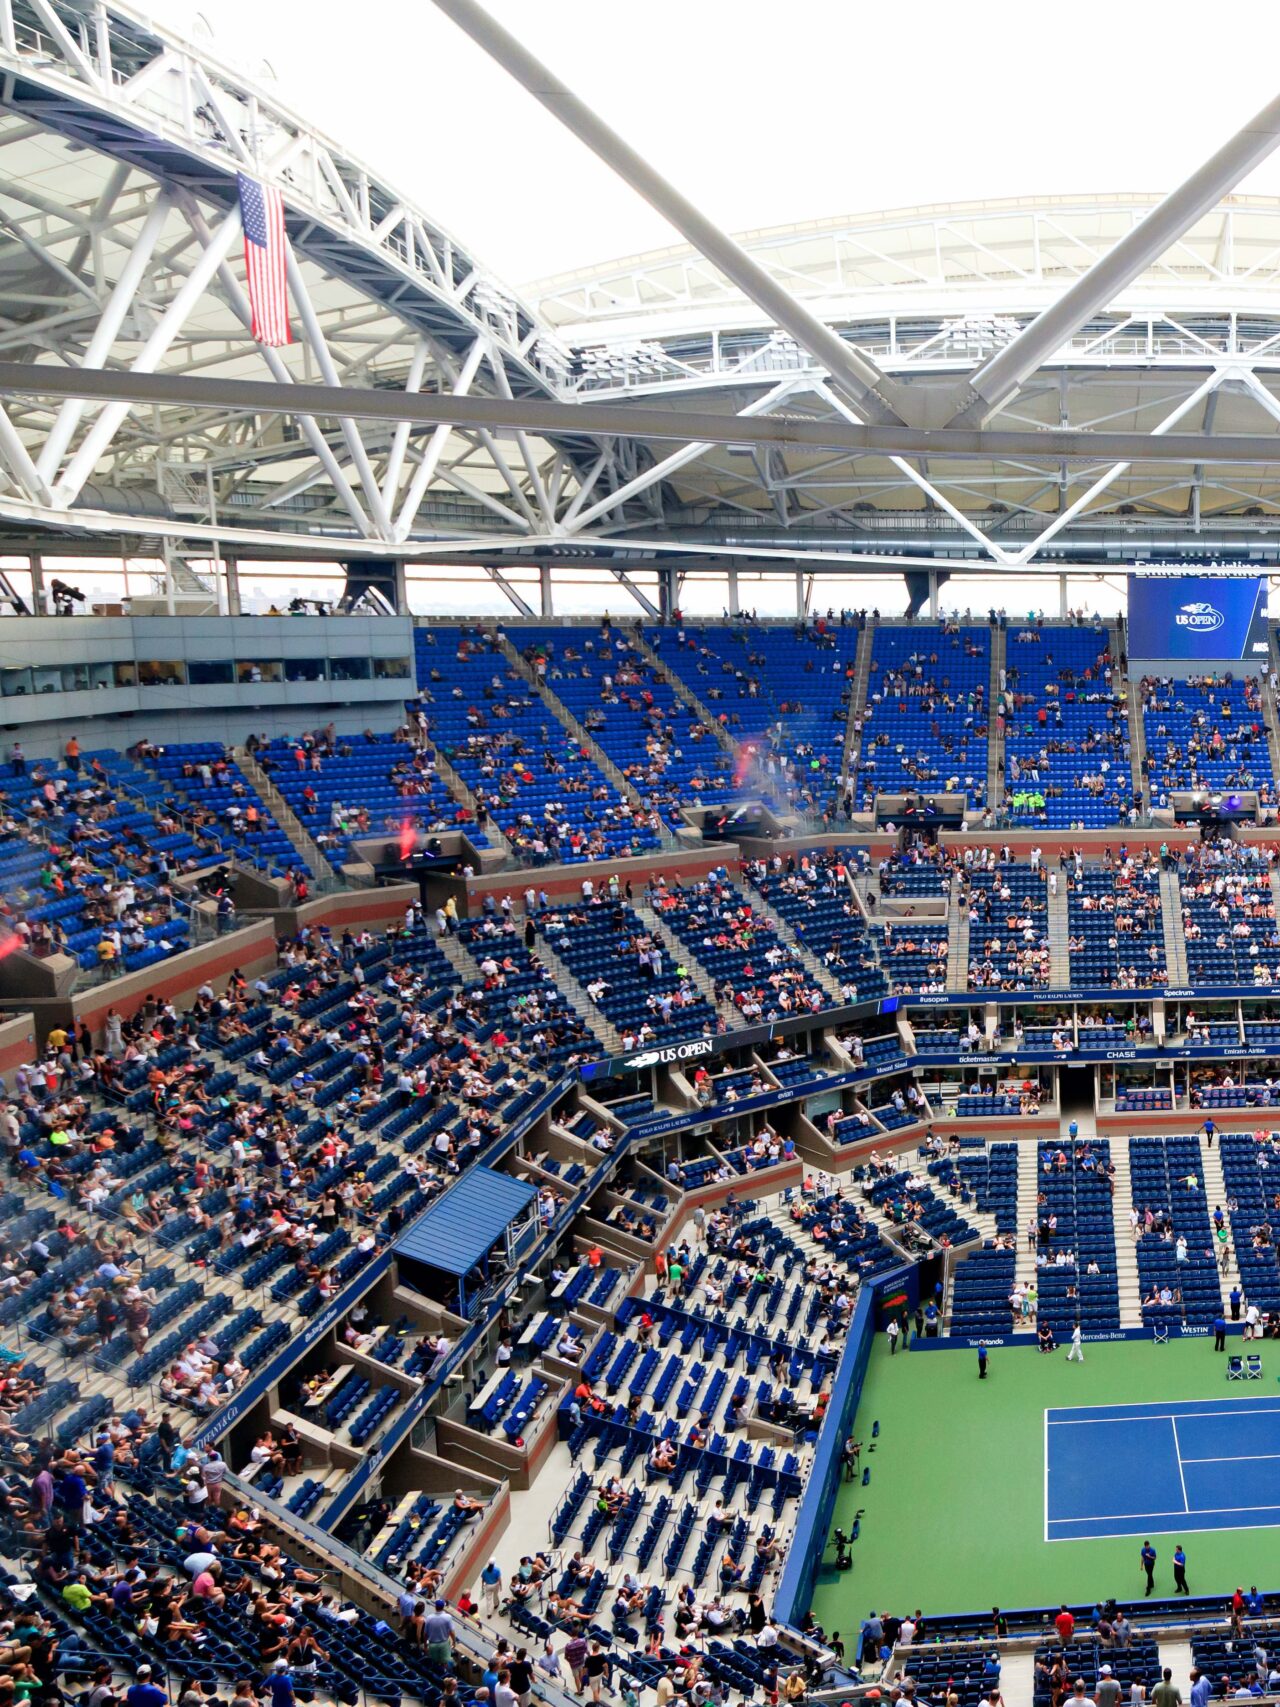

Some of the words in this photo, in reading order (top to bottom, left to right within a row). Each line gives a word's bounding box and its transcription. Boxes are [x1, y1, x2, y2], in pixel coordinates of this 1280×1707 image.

[1176, 615, 1188, 625] US
[1189, 615, 1217, 625] OPEN
[1163, 989, 1193, 998] Spectrum
[919, 996, 949, 1004] #usopen
[659, 1047, 676, 1063] US
[678, 1040, 713, 1059] OPEN
[1106, 1050, 1136, 1059] CHASE
[1223, 1047, 1247, 1055] Emirates
[959, 1055, 1000, 1064] ticketmaster
[876, 1065, 893, 1074] Mount
[777, 1089, 794, 1100] evian
[1180, 1326, 1209, 1334] WESTIN
